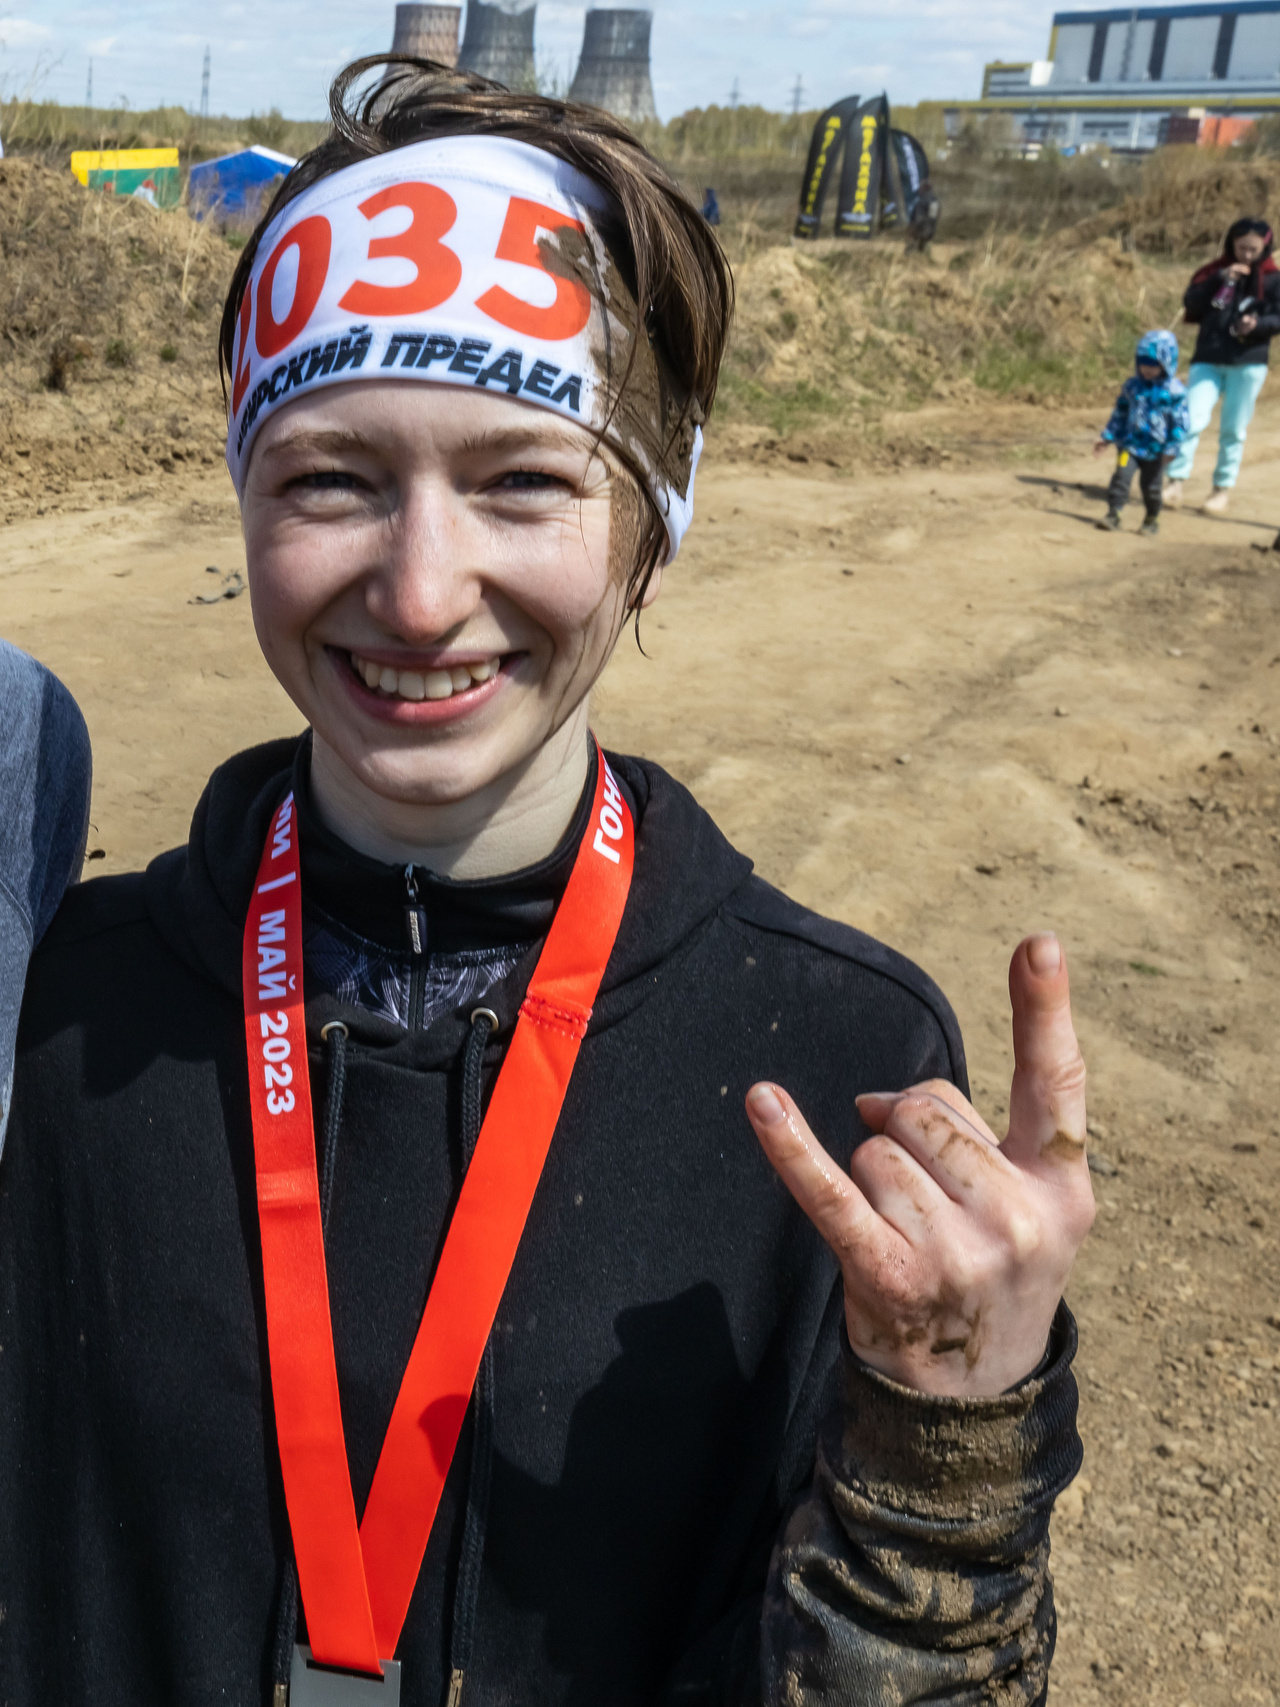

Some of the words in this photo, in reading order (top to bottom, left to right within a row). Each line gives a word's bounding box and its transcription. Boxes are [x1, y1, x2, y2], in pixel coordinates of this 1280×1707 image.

[233, 181, 591, 419] 2035
[380, 333, 582, 412] ПРЕДЕЛ
[257, 909, 296, 1000] МАЙ
[259, 1011, 296, 1115] 2023
